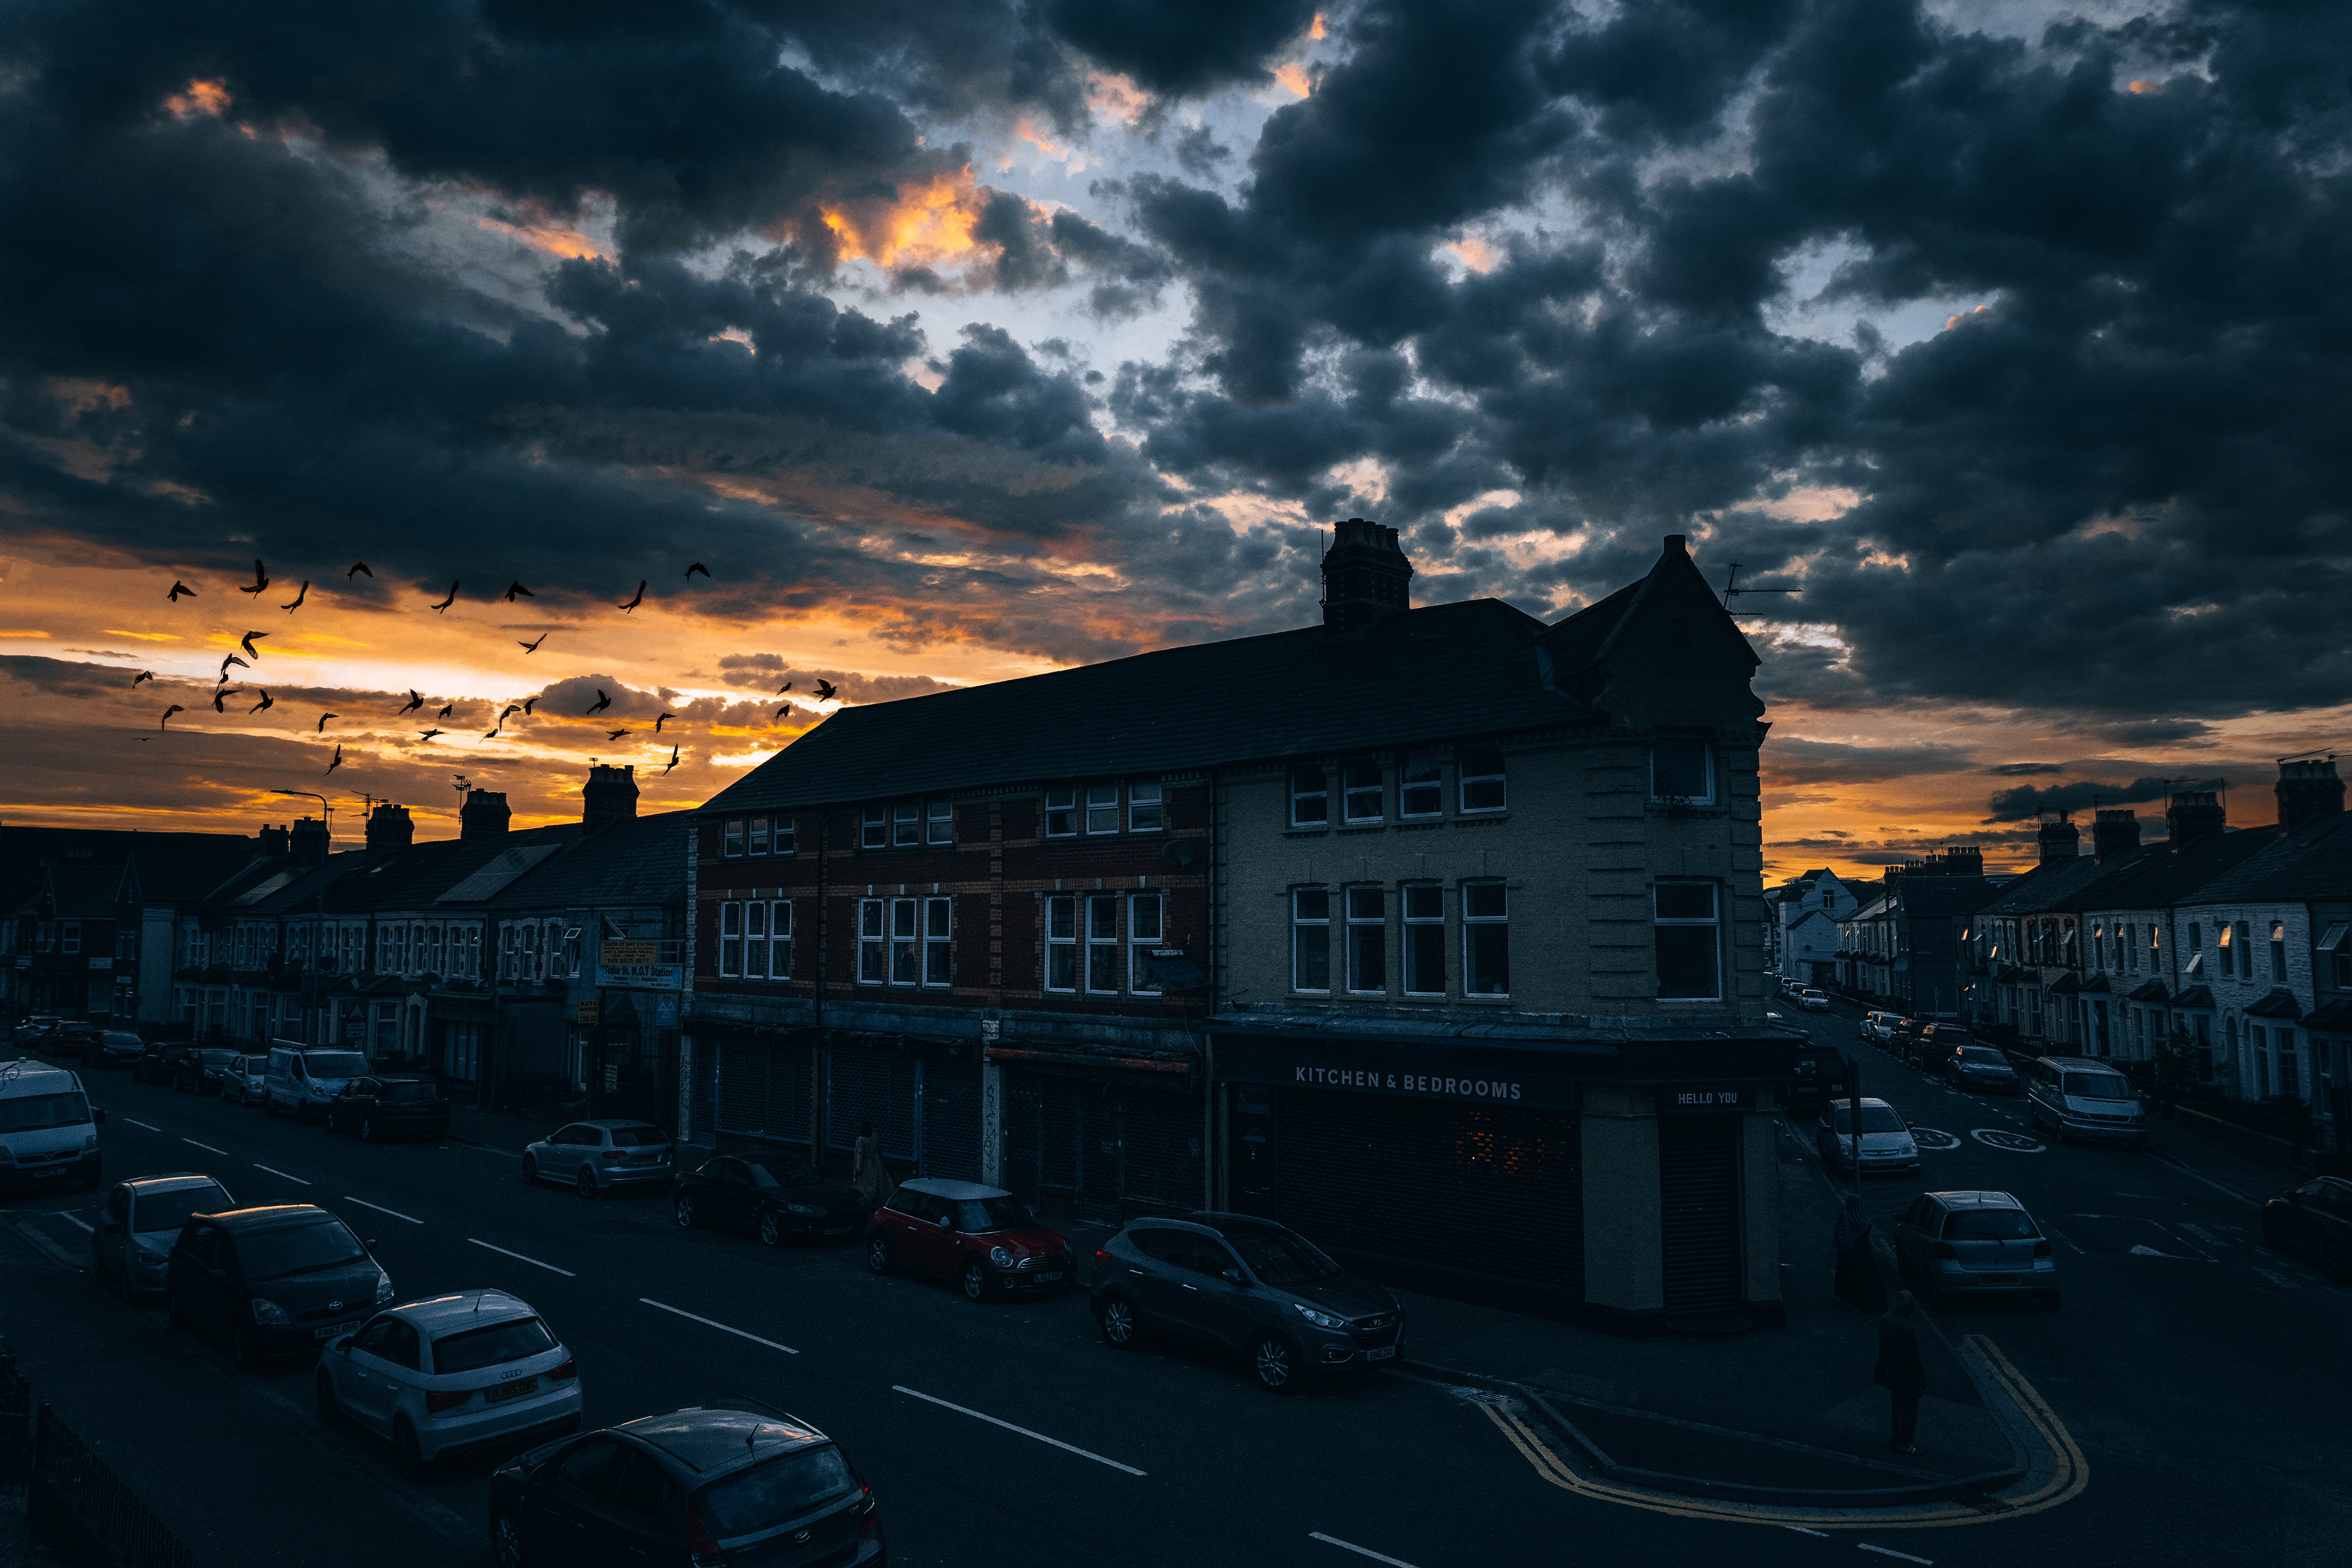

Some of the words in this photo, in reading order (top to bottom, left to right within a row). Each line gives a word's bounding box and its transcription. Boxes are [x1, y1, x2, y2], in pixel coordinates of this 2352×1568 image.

[605, 965, 620, 974] Tudor
[622, 966, 630, 975] St.
[631, 967, 649, 976] M.O.T
[650, 967, 673, 977] Station
[1295, 1066, 1379, 1087] KITCHEN
[1387, 1074, 1396, 1088] &
[1404, 1075, 1521, 1100] BEDROOMS
[1678, 1093, 1713, 1104] HELLO
[1718, 1092, 1737, 1104] YOU
[318, 1326, 340, 1336] FN57
[1370, 1350, 1382, 1359] EN61
[492, 1385, 517, 1399] BJ65
[519, 1379, 537, 1392] OWC
